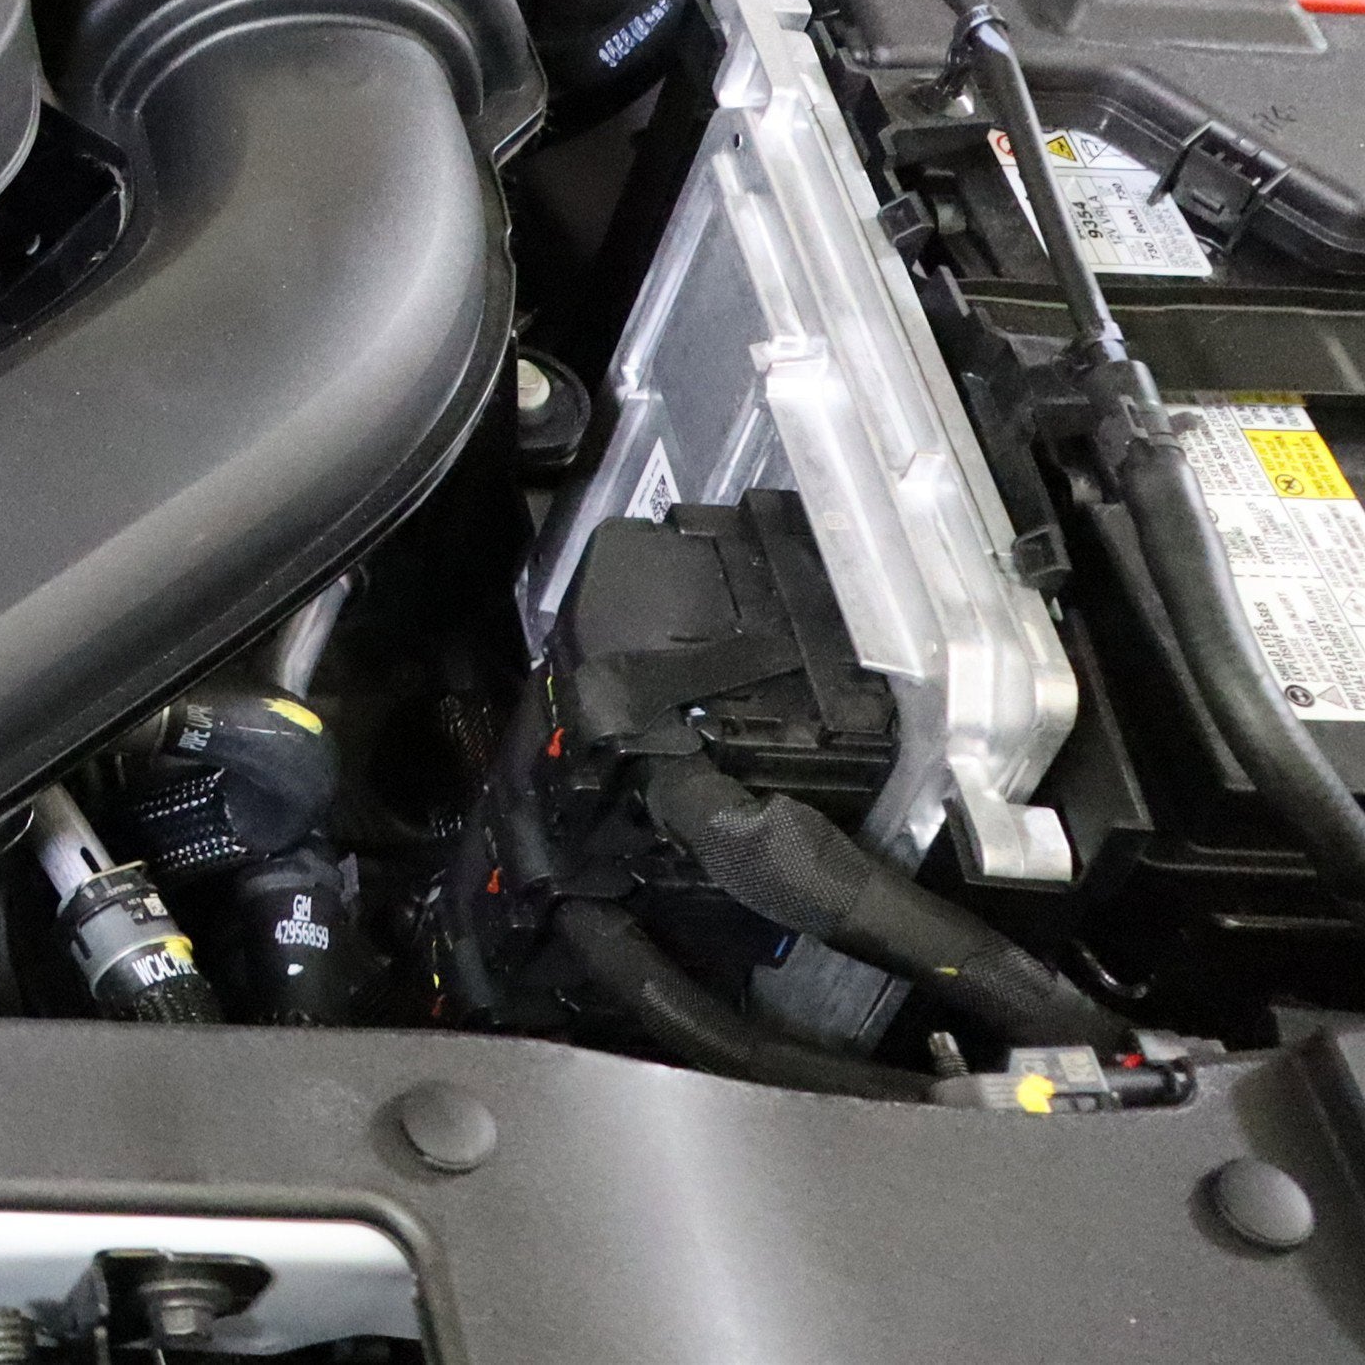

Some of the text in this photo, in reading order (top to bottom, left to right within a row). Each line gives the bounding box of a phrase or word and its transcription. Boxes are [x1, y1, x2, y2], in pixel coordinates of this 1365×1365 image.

[1111, 182, 1128, 199] 730
[1070, 200, 1104, 238] 9354
[1087, 195, 1112, 223] VRLA
[1126, 209, 1147, 234] 80Ah
[1103, 227, 1123, 244] 12V
[1144, 242, 1161, 259] 730
[1276, 592, 1299, 620] INJURY
[1253, 601, 1307, 681] EXPLOSIVE GASES
[1306, 619, 1328, 642] YEUX
[1288, 637, 1310, 663] CAUSE
[1300, 637, 1333, 682] BLINDNESS
[1320, 645, 1338, 660] LES
[1321, 623, 1357, 670] EXPLOSIFS
[1267, 650, 1293, 681] SHIELD
[292, 894, 312, 921] GM
[274, 919, 330, 950] 42956859
